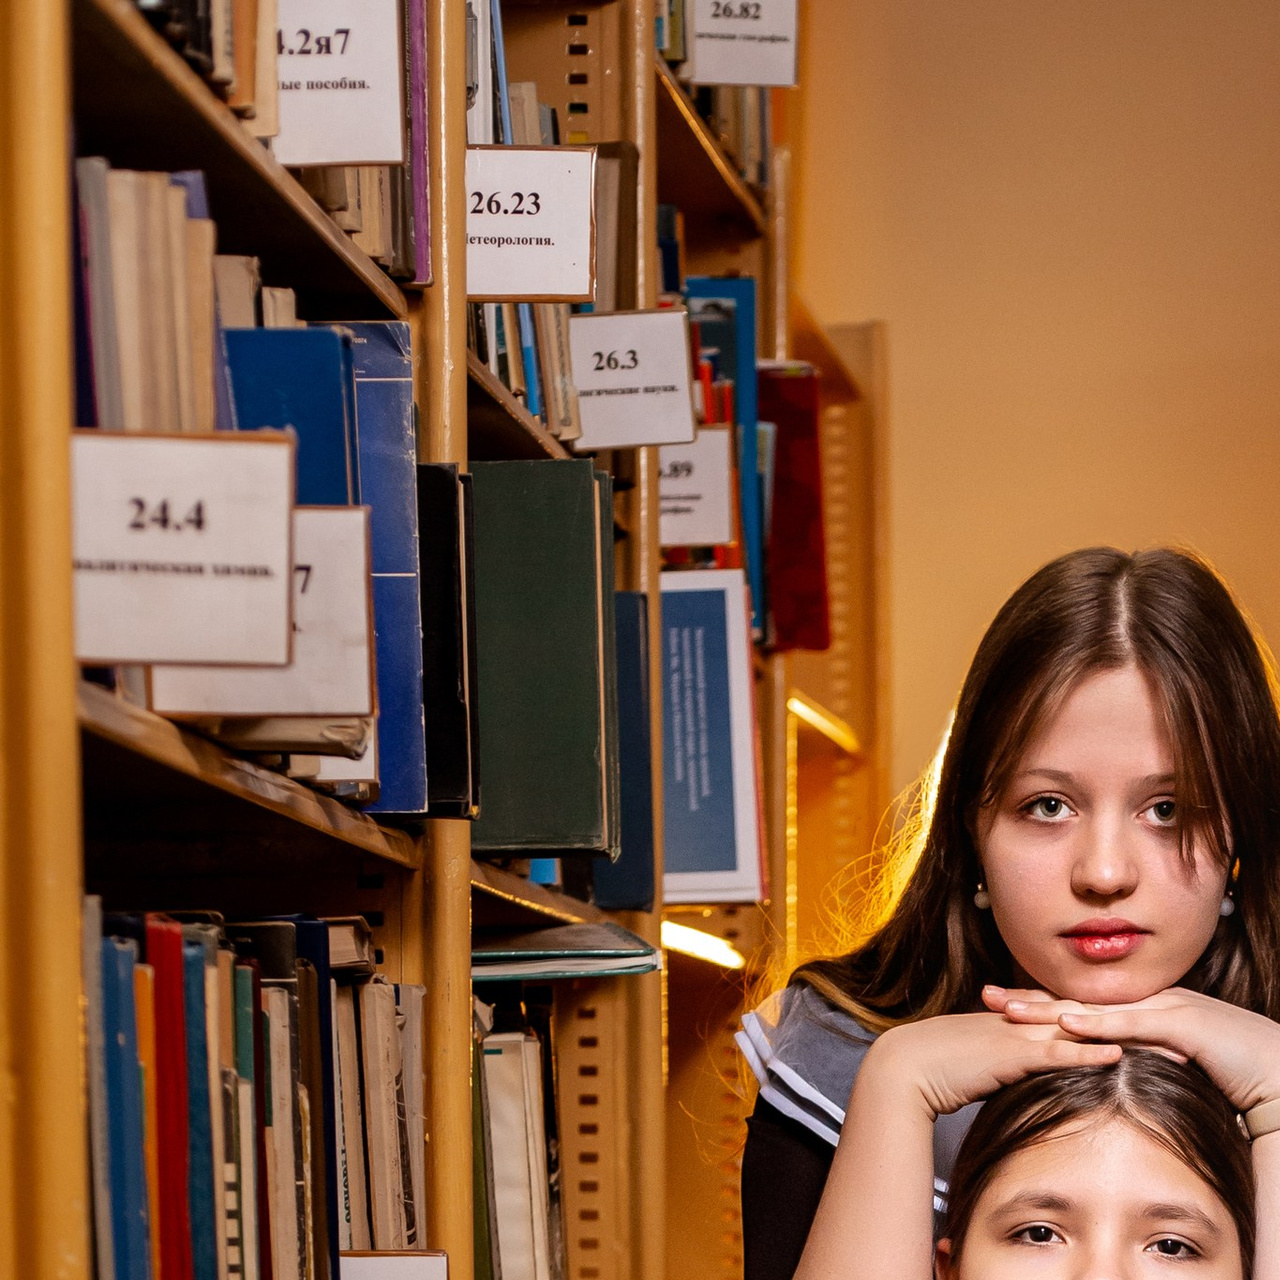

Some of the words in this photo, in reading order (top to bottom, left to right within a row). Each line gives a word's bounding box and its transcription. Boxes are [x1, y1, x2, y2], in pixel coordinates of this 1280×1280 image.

[278, 78, 301, 90] ые
[306, 77, 370, 90] пособия.
[470, 191, 541, 215] 26.23
[466, 233, 555, 248] етеорология.
[592, 350, 639, 371] 26.3
[129, 497, 206, 531] 24.4
